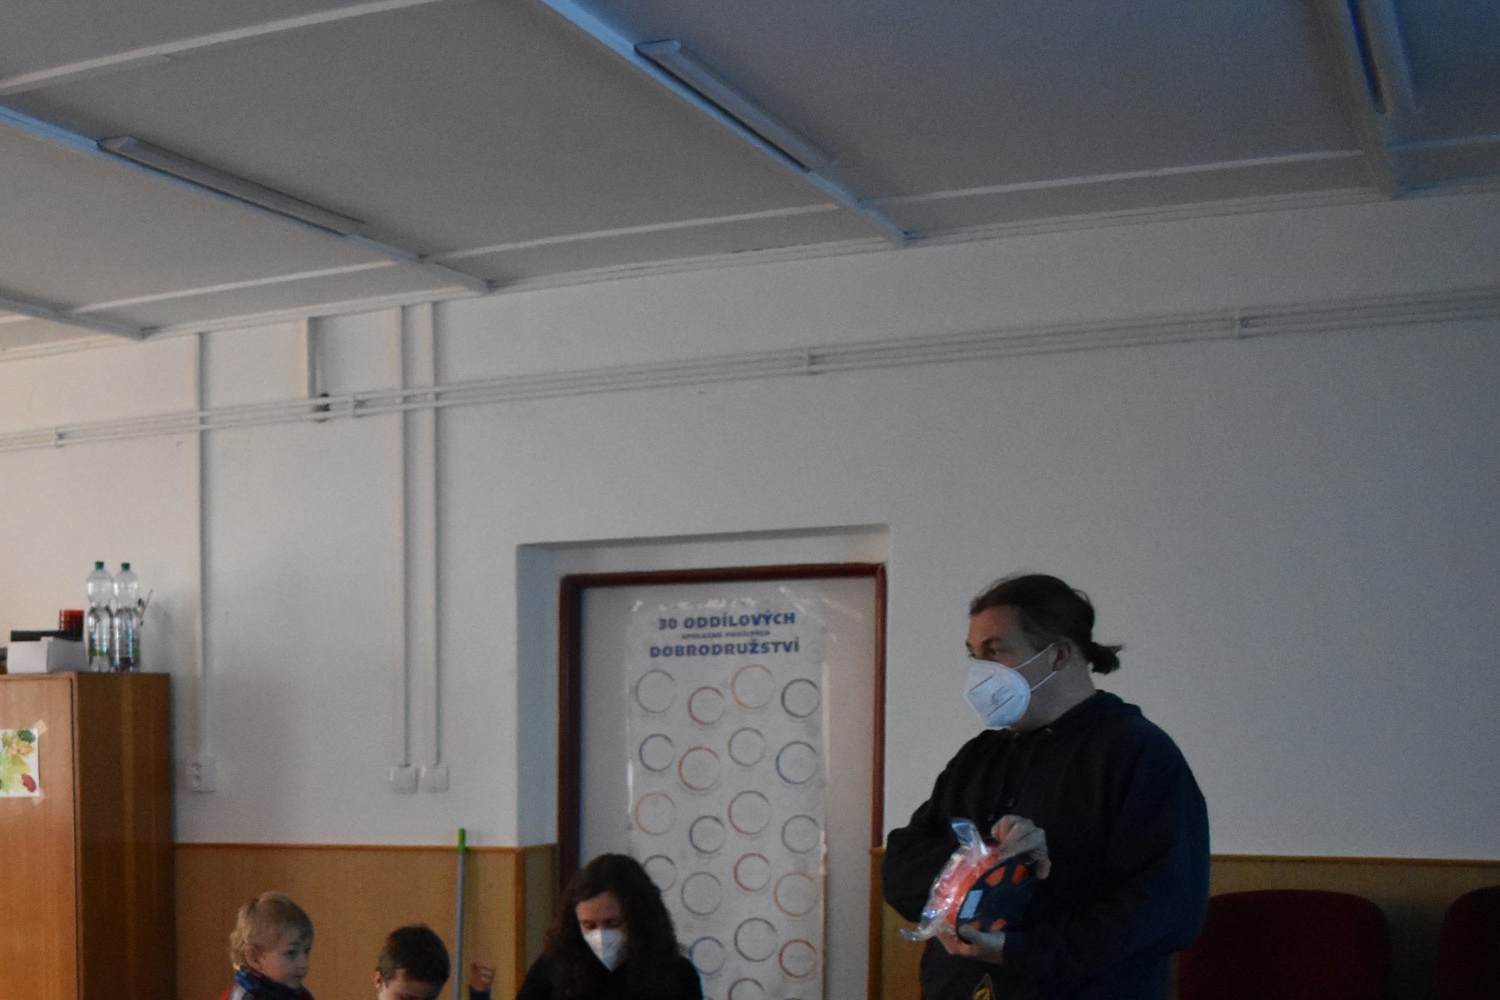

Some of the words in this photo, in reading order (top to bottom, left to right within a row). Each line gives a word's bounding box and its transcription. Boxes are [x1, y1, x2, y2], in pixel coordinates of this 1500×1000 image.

[658, 617, 678, 630] 30
[683, 609, 797, 629] ODDÍLOVÝCH
[649, 637, 800, 658] DOBRODRUŽSTVÍ
